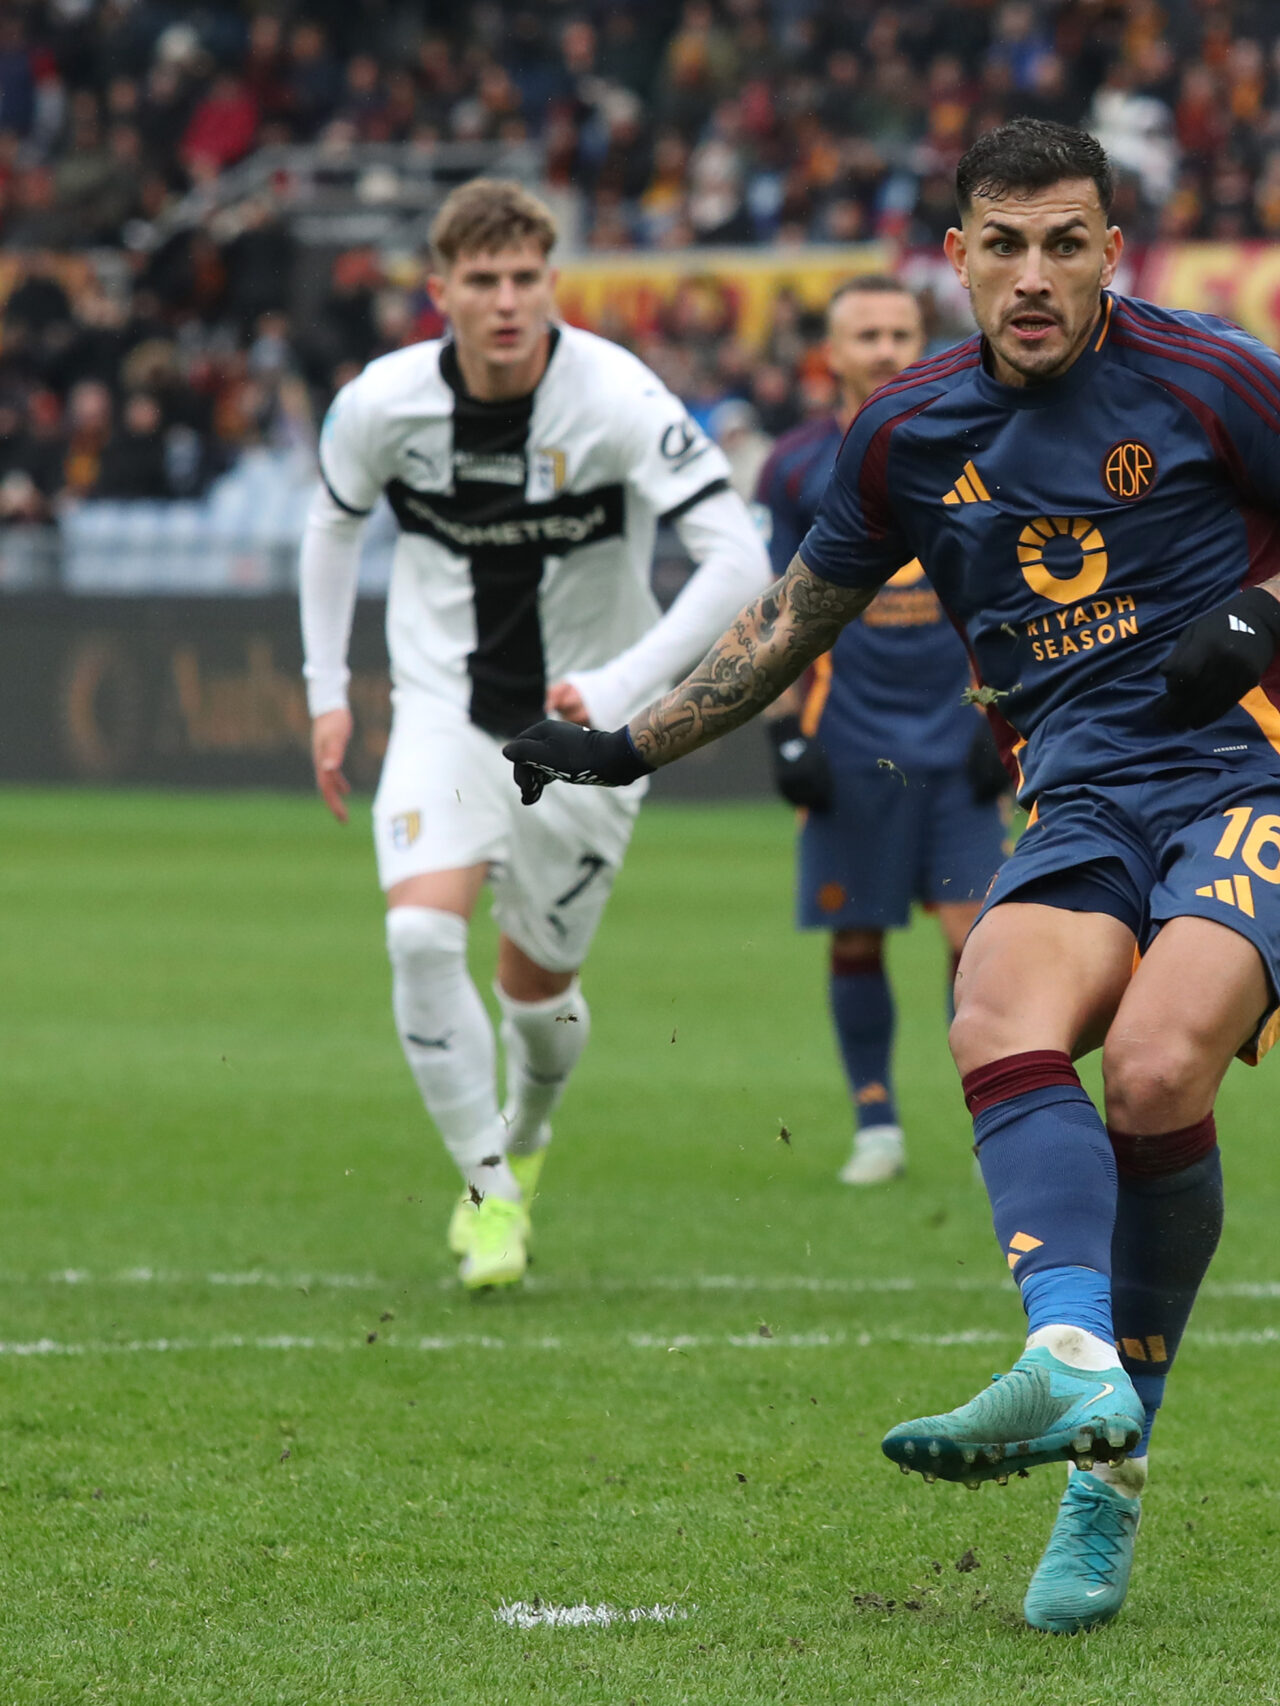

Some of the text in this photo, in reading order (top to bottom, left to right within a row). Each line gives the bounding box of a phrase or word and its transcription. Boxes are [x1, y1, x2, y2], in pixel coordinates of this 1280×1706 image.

[1105, 443, 1153, 497] ASR
[1026, 594, 1136, 637] RIYADH
[1031, 616, 1139, 661] SEASON
[555, 852, 606, 907] 7
